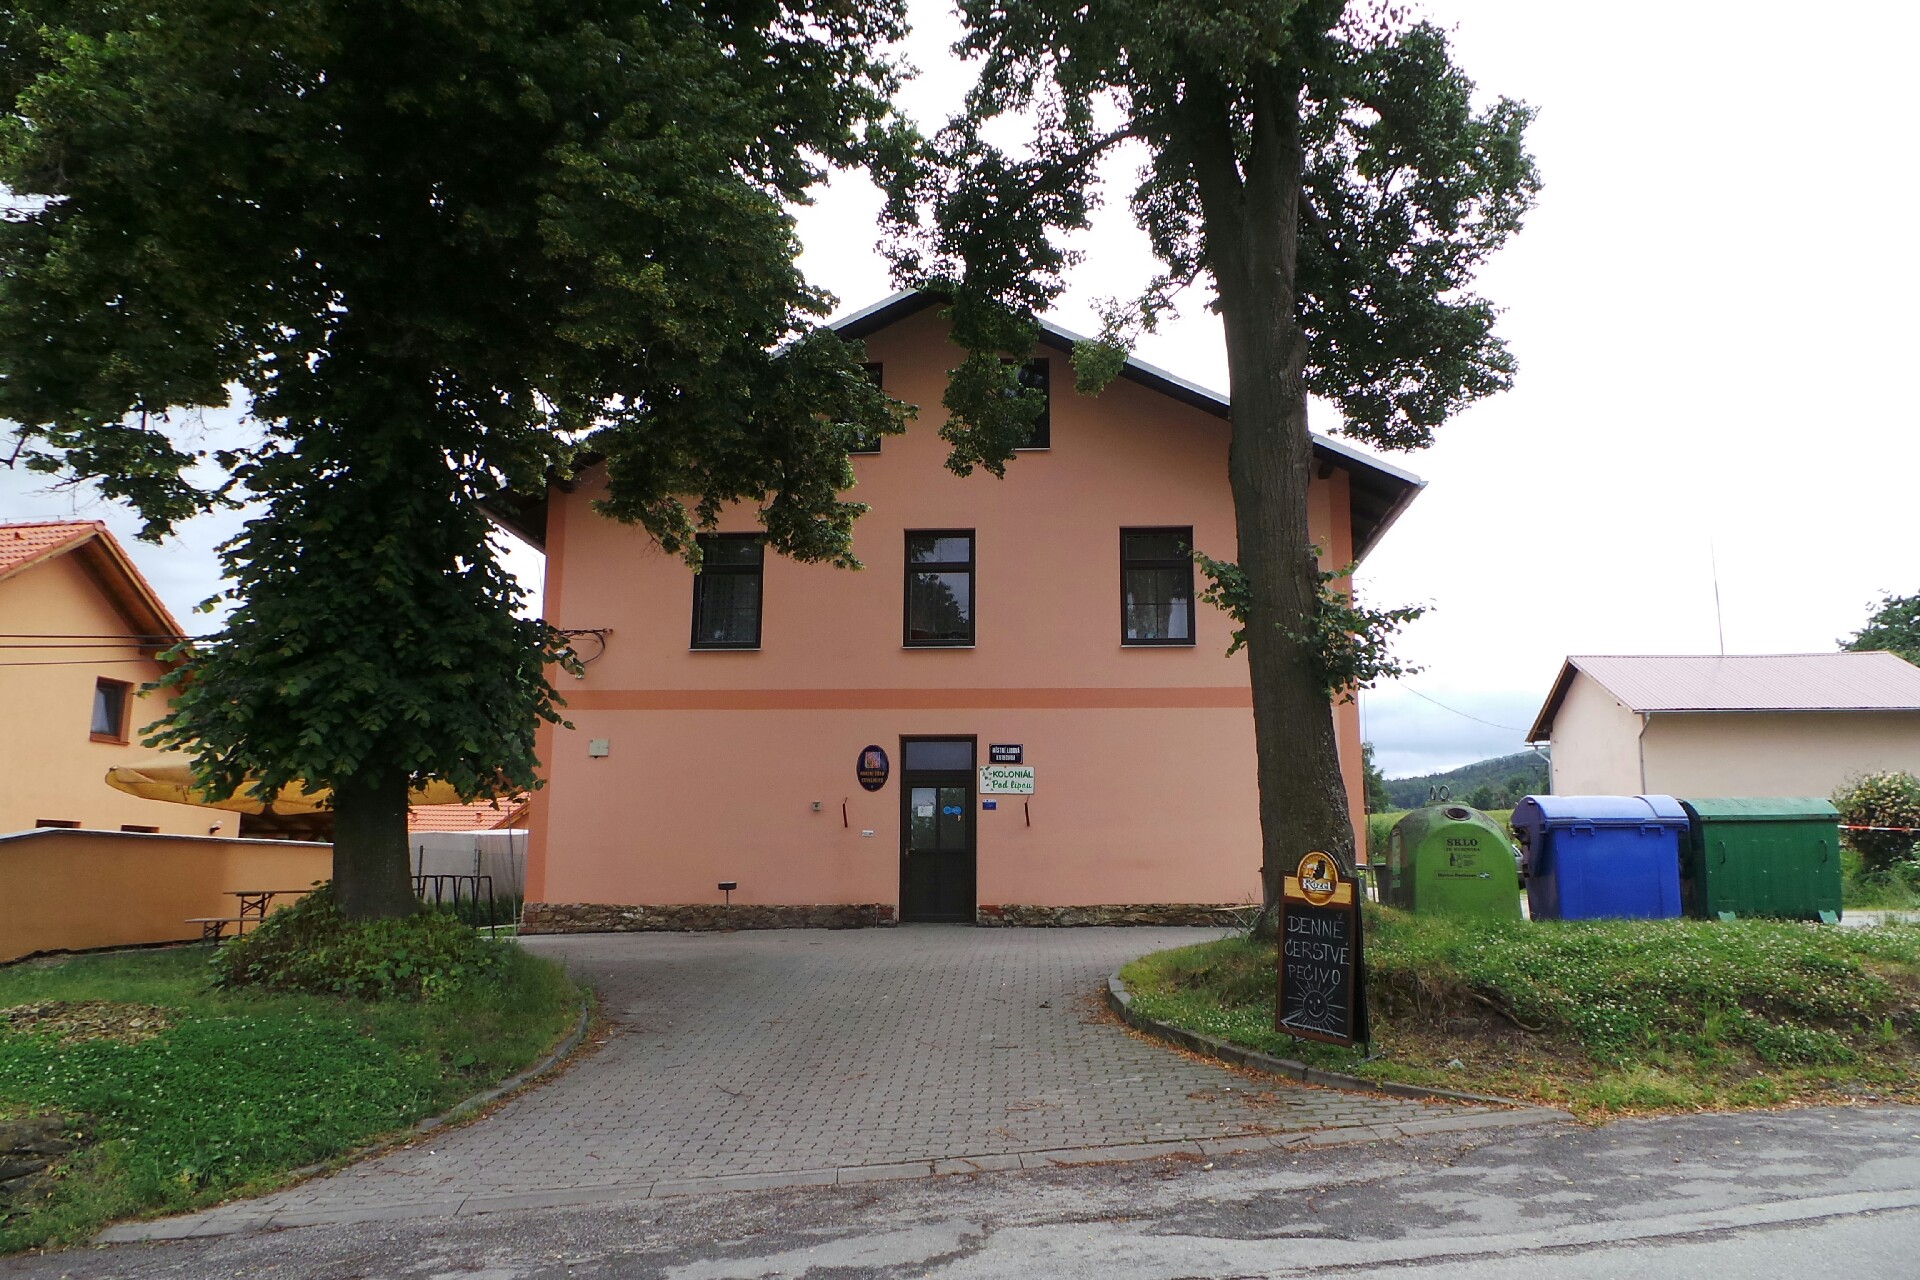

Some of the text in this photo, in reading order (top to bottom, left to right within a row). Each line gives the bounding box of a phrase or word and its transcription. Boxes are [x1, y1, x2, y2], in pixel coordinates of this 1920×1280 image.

[992, 769, 1034, 779] KOLONIÁL
[991, 779, 1032, 791] Pod lipou
[1446, 838, 1478, 847] SKLO
[1302, 876, 1333, 892] Kozel
[1287, 912, 1345, 939] DENNĚ
[1284, 938, 1351, 966] ČERSTVÉ
[1287, 963, 1341, 985] PEČIVO
